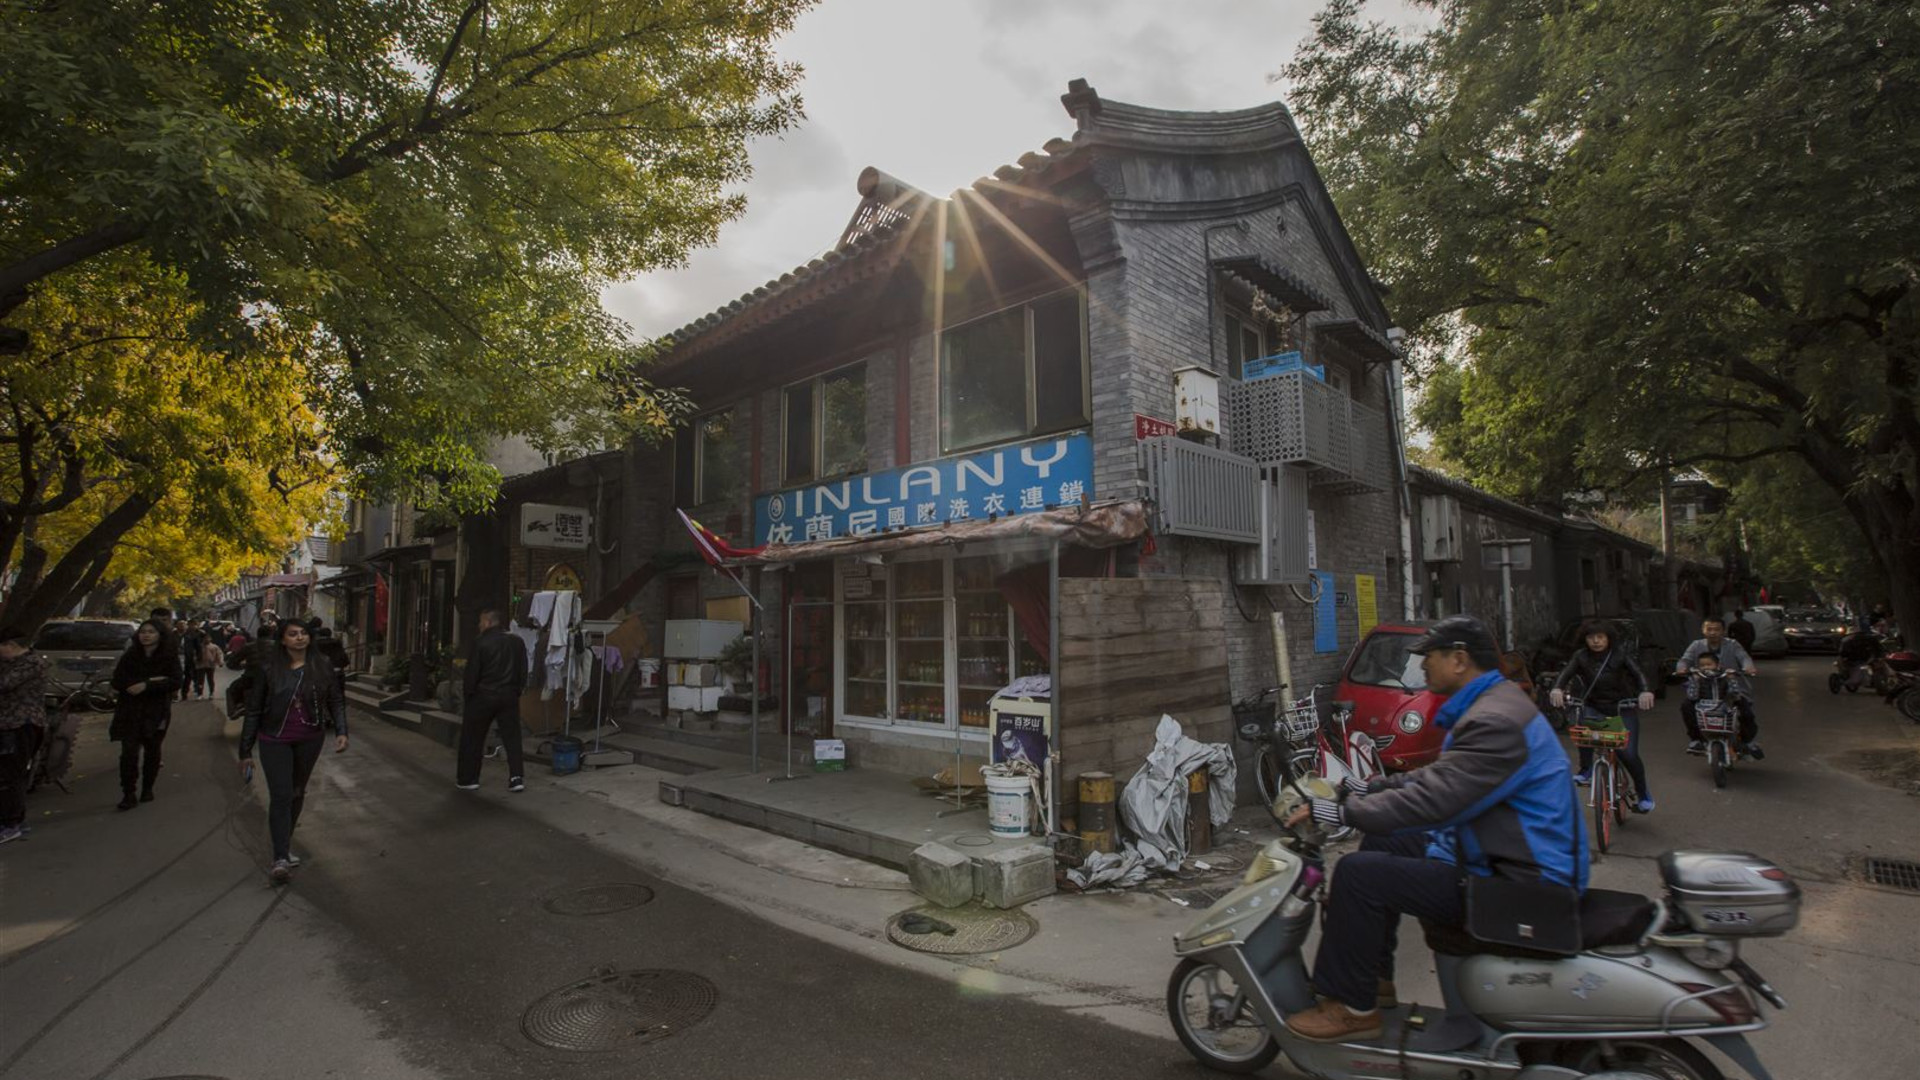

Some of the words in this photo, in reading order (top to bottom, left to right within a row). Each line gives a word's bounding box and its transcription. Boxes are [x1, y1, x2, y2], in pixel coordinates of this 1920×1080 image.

[796, 440, 1067, 517] INLANY
[1015, 716, 1040, 728] 百岁山
